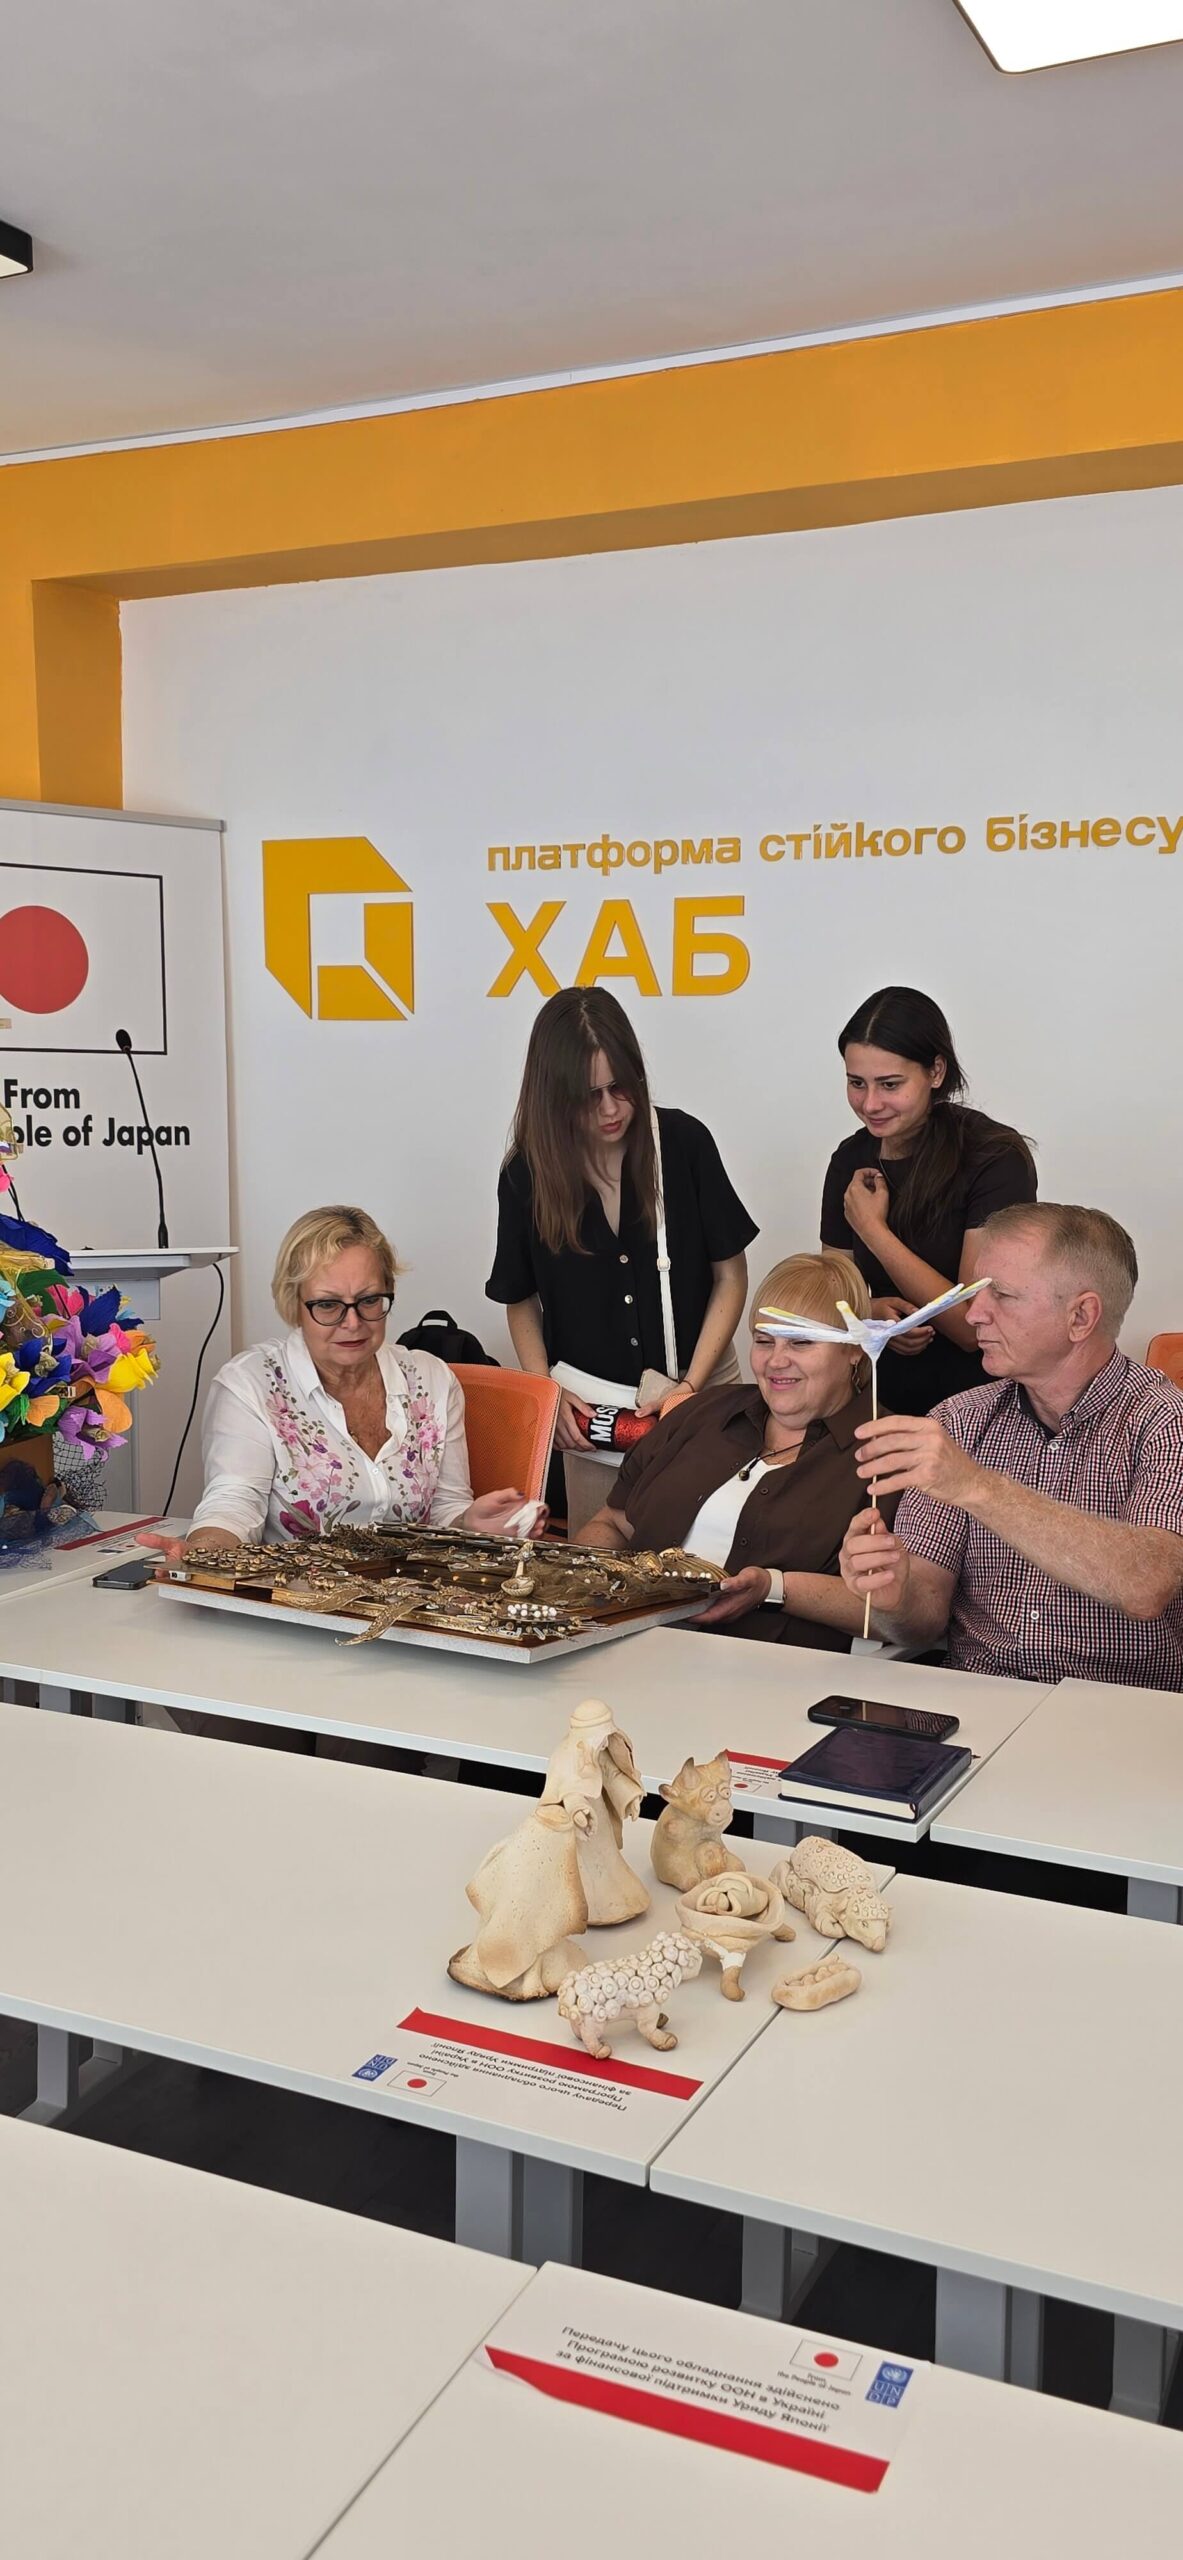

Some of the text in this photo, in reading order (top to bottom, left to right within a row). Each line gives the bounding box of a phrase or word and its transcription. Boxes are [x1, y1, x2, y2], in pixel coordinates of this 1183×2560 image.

[488, 813, 1183, 876] платформа стійкого бізнесу
[486, 895, 750, 997] ХАБ
[4, 1079, 80, 1109] From
[62, 1114, 93, 1147] of
[102, 1117, 190, 1155] Japan
[590, 1404, 619, 1443] MUS
[556, 2350, 829, 2433] за фінансової підтримки Уряду Японії
[562, 2326, 840, 2410] Передачу цього обладнання здійснено
[567, 2339, 648, 2368] Програмою
[651, 2364, 717, 2389] розвитку
[721, 2383, 756, 2399] ООН
